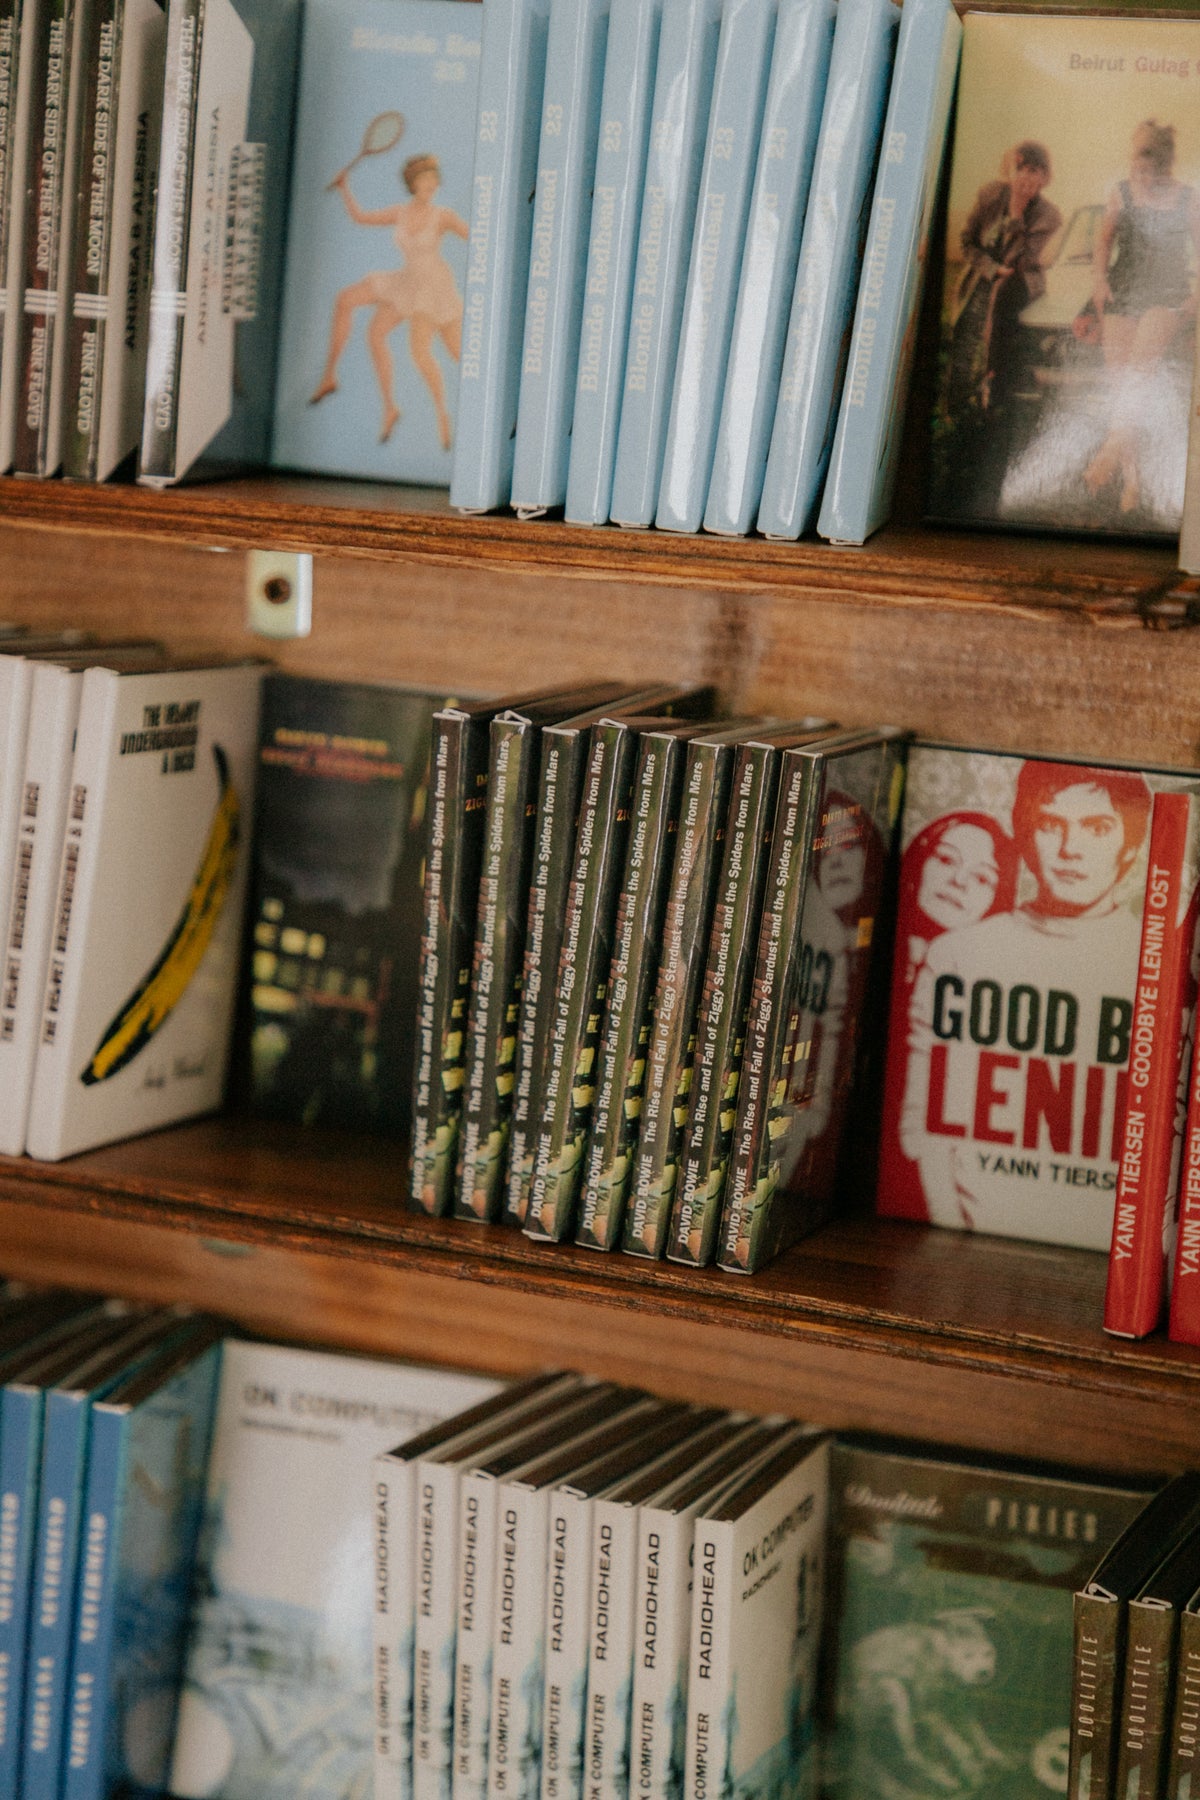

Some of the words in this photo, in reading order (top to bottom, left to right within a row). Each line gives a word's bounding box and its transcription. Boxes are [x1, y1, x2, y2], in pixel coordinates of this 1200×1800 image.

[50, 17, 63, 54] THE
[100, 21, 113, 56] THE
[47, 58, 61, 104] DARK
[1069, 53, 1125, 72] Beirut
[1134, 56, 1189, 79] Gulag
[96, 60, 111, 109] DARK
[44, 108, 58, 147] SIDE
[94, 111, 108, 150] SIDE
[479, 110, 498, 142] 23
[544, 104, 563, 135] 23
[601, 120, 622, 151] 23
[713, 127, 733, 158] 23
[765, 126, 787, 158] 23
[885, 131, 906, 162] 23
[42, 151, 56, 176] OF
[92, 154, 105, 179] OF
[40, 178, 54, 212] THE
[90, 180, 104, 216] THE
[468, 175, 493, 284] Redhead
[531, 168, 557, 278] Redhead
[588, 185, 615, 294] Redhead
[37, 216, 52, 270] MOON
[87, 219, 102, 274] MOON
[862, 197, 895, 308] Redhead
[31, 326, 45, 368] PINK
[462, 291, 485, 379] Blonde
[523, 286, 548, 373] Blonde
[580, 302, 605, 390] Blonde
[81, 331, 95, 372] PINK
[849, 317, 877, 406] Blonde
[28, 372, 43, 429] FLOYD
[78, 377, 93, 433] FLOYD
[591, 740, 605, 774] Mars
[643, 752, 656, 786] Mars
[587, 777, 600, 805] from
[690, 761, 703, 794] Mars
[740, 762, 754, 796] Mars
[788, 770, 802, 804] Mars
[638, 788, 651, 817] from
[686, 797, 699, 826] from
[736, 798, 749, 828] from
[580, 808, 596, 856] Spiders
[784, 807, 797, 836] from
[632, 820, 647, 868] Spiders
[680, 828, 695, 876] Spiders
[729, 830, 745, 879] Spiders
[577, 858, 589, 879] the
[628, 869, 640, 891] the
[777, 839, 792, 887] Spiders
[573, 881, 586, 905] and
[676, 878, 688, 900] the
[726, 880, 738, 903] the
[773, 889, 785, 911] the
[1147, 865, 1171, 908] OST
[625, 893, 637, 917] and
[673, 903, 685, 926] and
[722, 905, 734, 929] and
[565, 908, 582, 962] Stardust
[770, 913, 782, 937] and
[617, 919, 634, 973] Stardust
[666, 928, 682, 983] Stardust
[714, 931, 731, 986] Stardust
[1140, 913, 1167, 980] LENIN!
[560, 964, 575, 1000] Ziggy
[762, 939, 778, 994] Stardust
[558, 1001, 569, 1015] of
[612, 976, 627, 1012] Ziggy
[661, 985, 676, 1021] Ziggy
[709, 989, 724, 1024] Ziggy
[554, 1018, 567, 1040] Fall
[610, 1014, 621, 1027] of
[659, 1022, 670, 1036] of
[756, 997, 772, 1032] Ziggy
[932, 974, 1078, 1056] GOOD
[607, 1030, 619, 1053] Fall
[656, 1039, 668, 1062] Fall
[707, 1026, 717, 1040] of
[754, 1034, 765, 1048] of
[1129, 986, 1160, 1088] GOODBYE
[551, 1042, 563, 1066] and
[603, 1055, 615, 1078] and
[703, 1043, 715, 1065] Fall
[751, 1050, 763, 1073] Fall
[547, 1068, 560, 1096] Rise
[652, 1064, 664, 1088] and
[699, 1067, 712, 1091] and
[747, 1076, 759, 1099] and
[543, 1099, 555, 1122] The
[599, 1081, 612, 1109] Rise
[648, 1090, 661, 1118] Rise
[695, 1093, 708, 1122] Rise
[596, 1111, 608, 1134] The
[645, 1120, 657, 1144] The
[743, 1102, 756, 1130] Rise
[692, 1124, 704, 1148] The
[739, 1132, 752, 1156] The
[1119, 1110, 1147, 1195] TIERSEN
[536, 1133, 551, 1176] BOWIE
[588, 1144, 603, 1188] BOWIE
[978, 1152, 1040, 1179] YANN
[1050, 1162, 1119, 1191] TIERS
[638, 1153, 653, 1197] BOWIE
[684, 1159, 699, 1202] BOWIE
[732, 1166, 747, 1210] BOWIE
[530, 1179, 544, 1218] DAVID
[583, 1189, 597, 1229] DAVID
[633, 1199, 647, 1238] DAVID
[678, 1204, 693, 1244] DAVID
[726, 1211, 741, 1251] DAVID
[1113, 1203, 1138, 1260] YANN
[1179, 1220, 1200, 1277] YANN
[376, 1482, 388, 1613] RADIOHEAD
[420, 1483, 433, 1616] RADIOHEAD
[462, 1497, 477, 1630] RADIOHEAD
[500, 1509, 517, 1644] RADIOHEAD
[550, 1516, 566, 1652] RADIOHEAD
[594, 1524, 613, 1661] RADIOHEAD
[643, 1532, 661, 1669] RADIOHEAD
[698, 1542, 717, 1679] RADIOHEAD
[379, 1646, 388, 1728] COMPUTER
[419, 1649, 431, 1733] COMPUTER
[1077, 1635, 1098, 1737] DOOLITTLE
[1126, 1645, 1151, 1749] DOOLITTLE
[459, 1664, 472, 1748] COMPUTER
[496, 1677, 510, 1764] COMPUTER
[379, 1735, 389, 1754] OK
[547, 1684, 561, 1771] COMPUTER
[590, 1693, 606, 1780] COMPUTER
[640, 1701, 655, 1788] COMPUTER
[419, 1739, 430, 1759] OK
[459, 1754, 469, 1774] OK
[693, 1711, 709, 1800] COMPUTER
[495, 1769, 506, 1790] OK
[547, 1776, 558, 1797] OK
